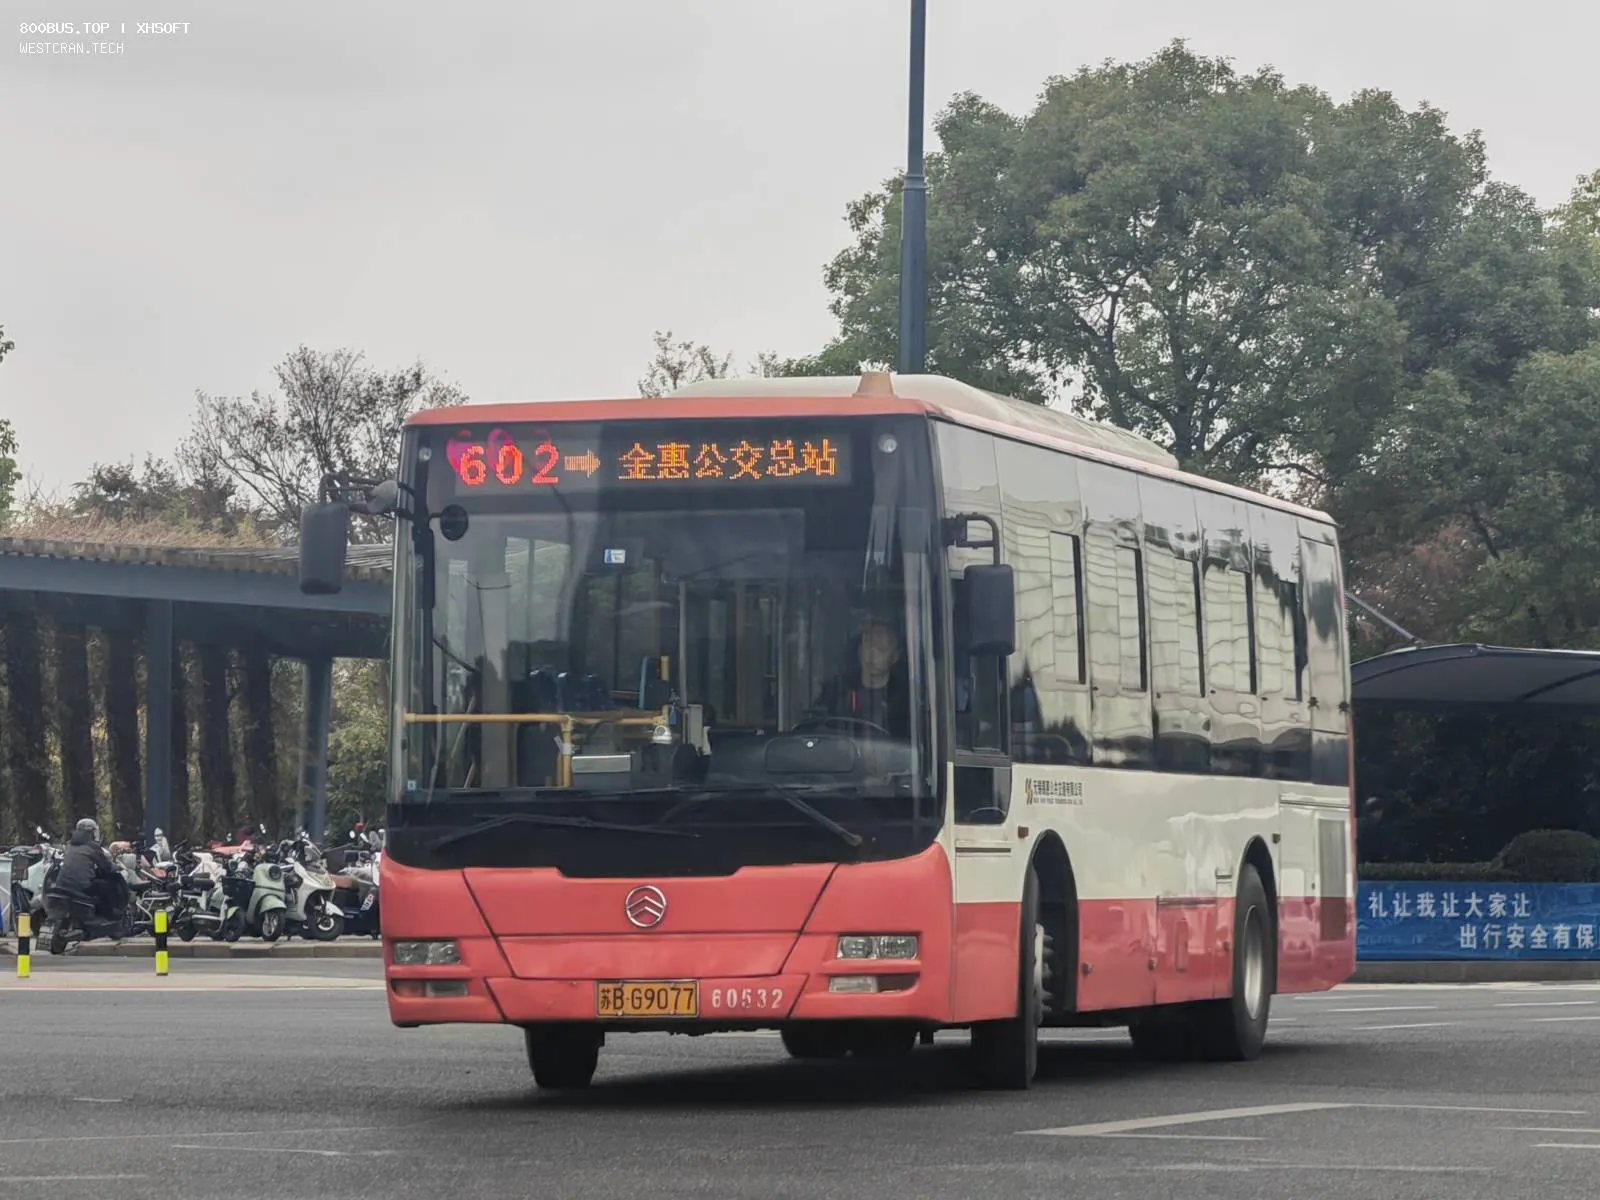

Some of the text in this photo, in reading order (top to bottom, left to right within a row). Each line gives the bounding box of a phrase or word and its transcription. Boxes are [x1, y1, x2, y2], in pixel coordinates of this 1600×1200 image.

[459, 440, 560, 487] 602
[617, 438, 838, 480] 金惠公交总站
[1368, 891, 1532, 919] 礼让我让大家让
[1458, 922, 1600, 950] 出行安全有保
[711, 987, 784, 1009] 60532
